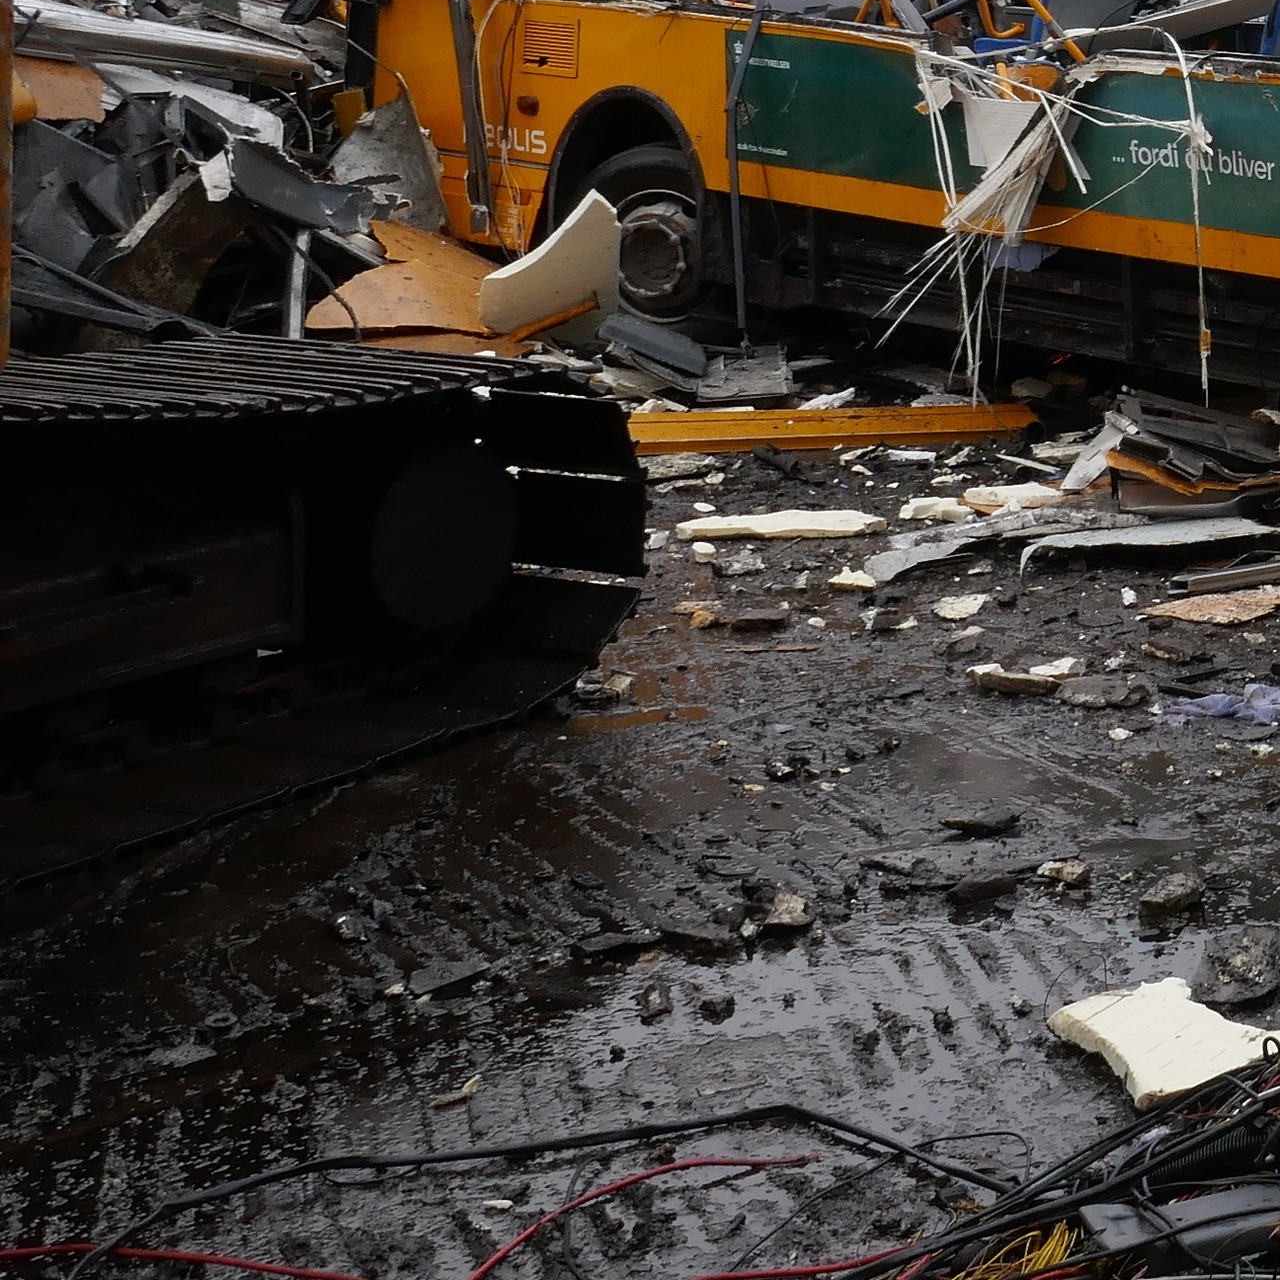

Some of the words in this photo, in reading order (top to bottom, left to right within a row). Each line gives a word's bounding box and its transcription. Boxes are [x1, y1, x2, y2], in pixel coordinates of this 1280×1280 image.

[463, 121, 547, 154] EOLIS
[1129, 140, 1179, 168] fordi
[1217, 149, 1274, 181] bliver
